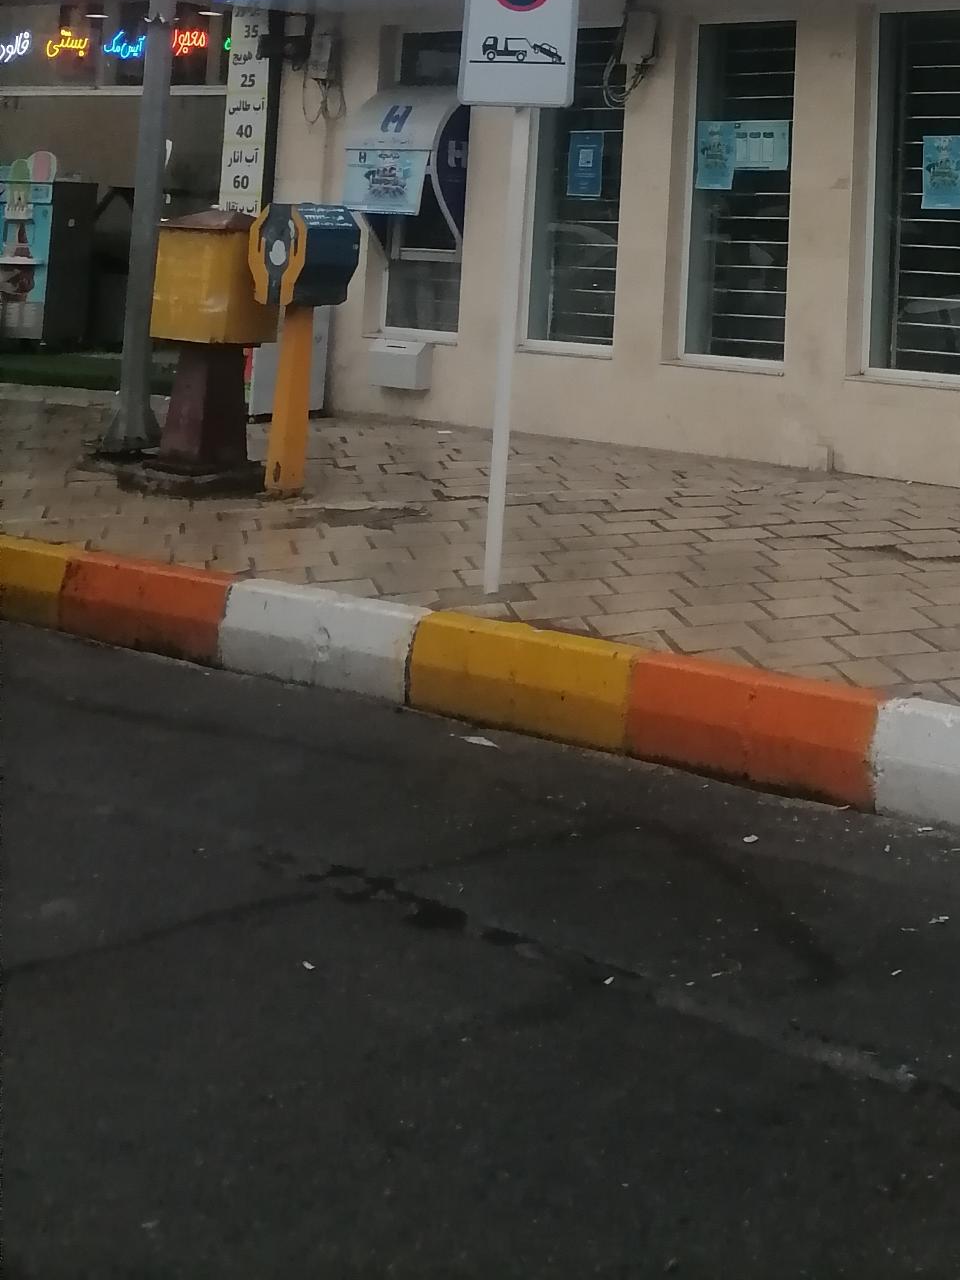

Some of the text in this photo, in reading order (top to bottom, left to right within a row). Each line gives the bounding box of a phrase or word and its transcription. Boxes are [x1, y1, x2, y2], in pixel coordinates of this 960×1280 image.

[244, 24, 259, 39] 35
[46, 29, 90, 58] بستنی
[172, 28, 206, 57] معجو
[240, 73, 256, 88] 25
[253, 97, 266, 115] آب
[235, 124, 253, 139] 40
[227, 147, 260, 168] آب انار
[232, 175, 250, 190] 60
